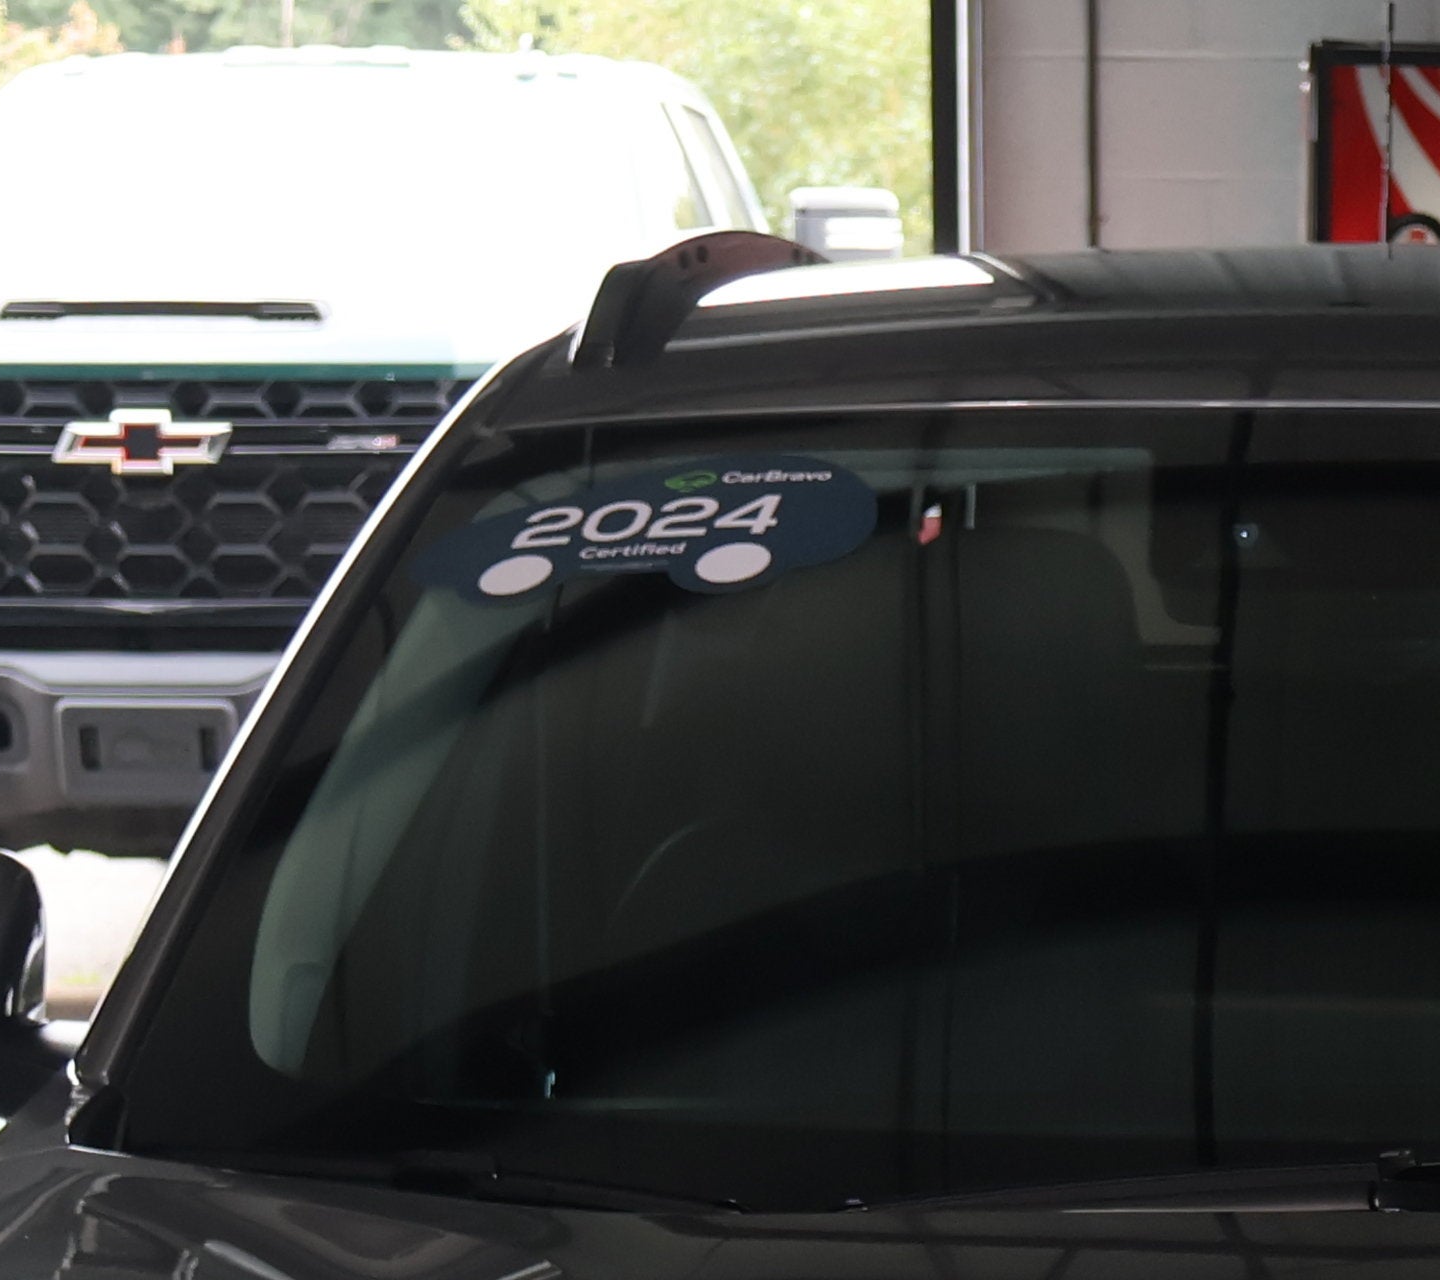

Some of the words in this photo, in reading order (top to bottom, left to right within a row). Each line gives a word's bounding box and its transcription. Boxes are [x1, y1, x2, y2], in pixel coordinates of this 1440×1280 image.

[722, 469, 832, 484] CarBravo
[511, 494, 782, 550] 2024
[579, 542, 687, 560] Certified
